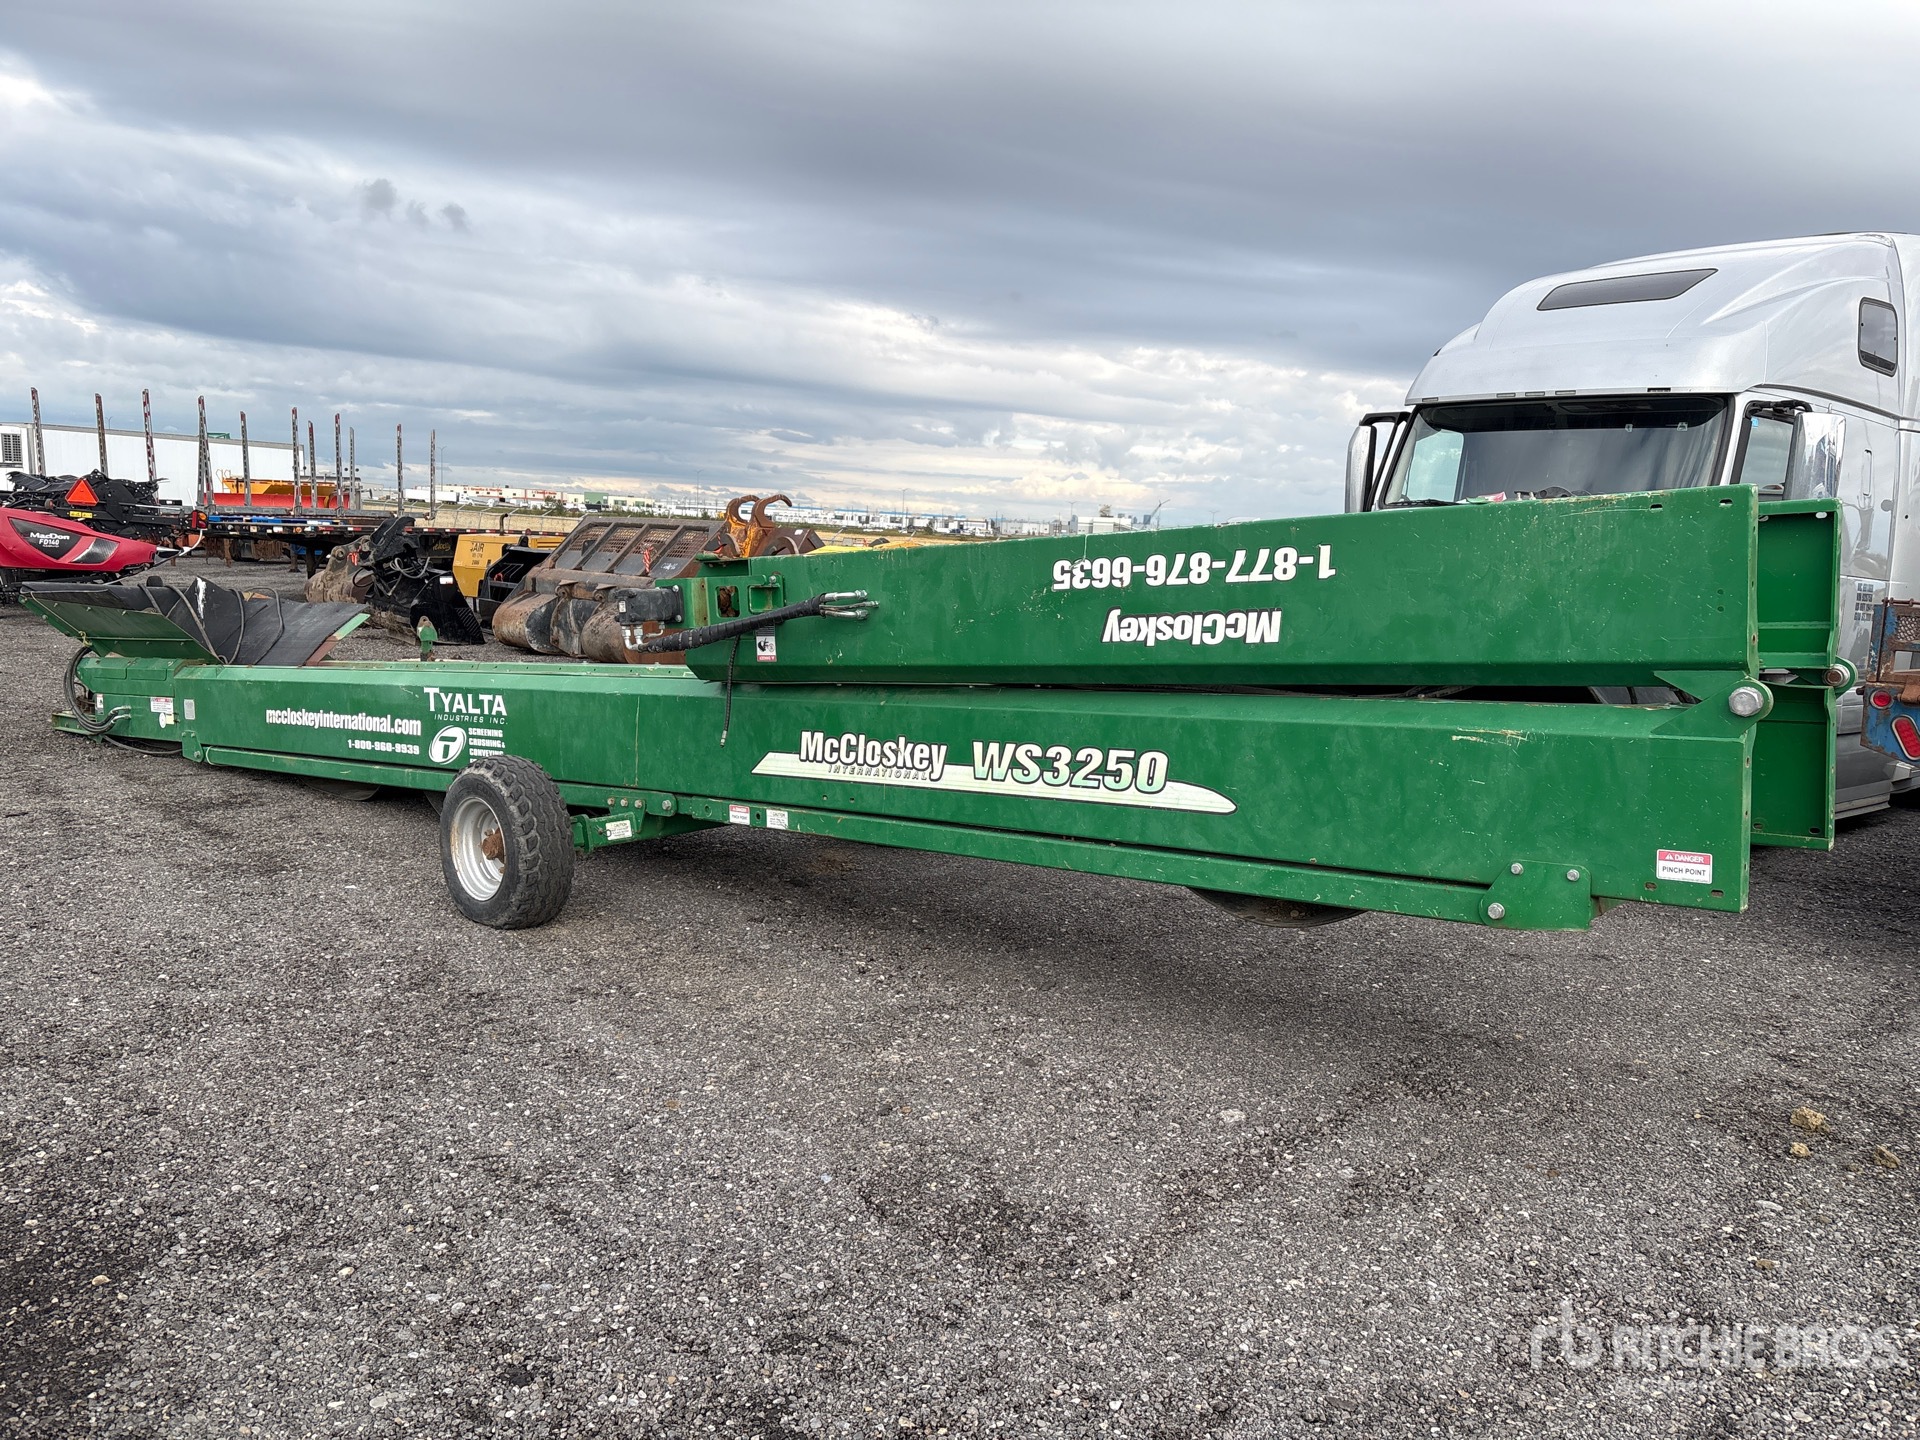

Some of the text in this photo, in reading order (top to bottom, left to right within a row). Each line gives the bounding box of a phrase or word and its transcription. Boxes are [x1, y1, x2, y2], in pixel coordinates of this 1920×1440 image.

[30, 532, 70, 540] MadDon
[1052, 544, 1337, 591] 1-877-876-6635
[1101, 606, 1282, 647] McCloskey
[266, 708, 421, 736] mccloskeyinternational.com
[434, 714, 508, 725] INDUSTRIES INC.
[468, 728, 503, 737] SCREENING
[468, 737, 501, 748] CRUSHING
[800, 731, 1170, 794] McCloskey WS3250
[828, 765, 928, 780] INTERNATIONAL
[1674, 854, 1705, 863] DANGER
[1662, 866, 1706, 876] PINCH POINT
